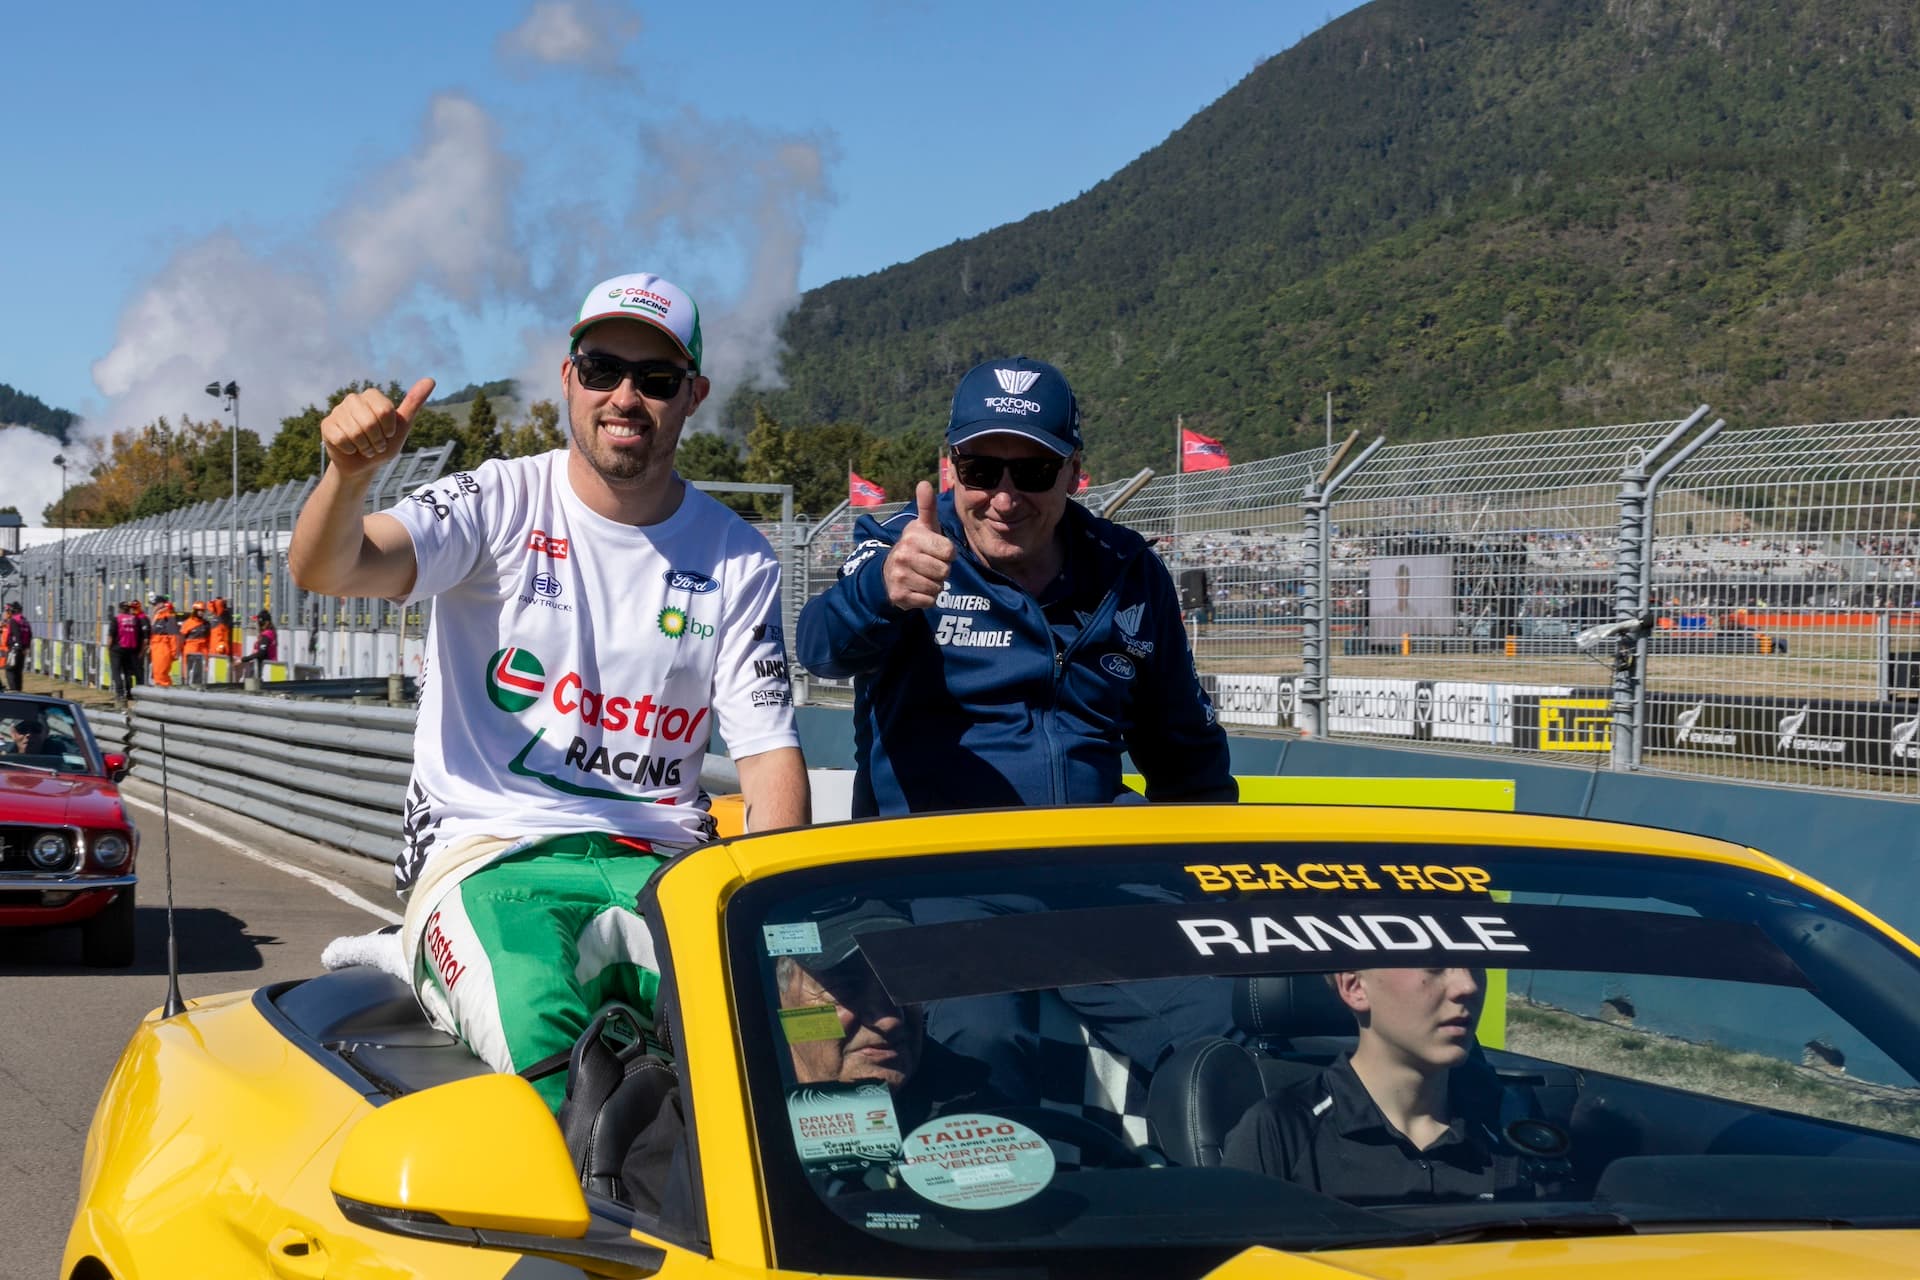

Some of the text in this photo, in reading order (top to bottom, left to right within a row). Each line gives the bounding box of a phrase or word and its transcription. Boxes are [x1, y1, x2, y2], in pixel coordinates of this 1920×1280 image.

[625, 288, 671, 307] Castrol
[632, 297, 668, 314] RACING
[984, 397, 1041, 413] TICKFORD
[996, 406, 1027, 416] RACING
[671, 574, 708, 592] Ford
[540, 599, 573, 612] TRUCKS
[690, 617, 714, 640] bp
[935, 615, 973, 647] 55
[962, 630, 1013, 647] RANDLE
[1108, 655, 1131, 676] Ford
[553, 671, 709, 744] Castrol
[564, 735, 682, 787] RACING
[1184, 863, 1491, 892] BEACH HOP
[1177, 915, 1531, 956] RANDLE
[427, 911, 466, 992] Castrol
[799, 1113, 854, 1125] DRIVER
[800, 1120, 856, 1131] PARADE
[802, 1126, 857, 1138] VEHICLE
[905, 1140, 1043, 1166] DRIVER PARADE
[939, 1153, 1017, 1170] VEHICLE
